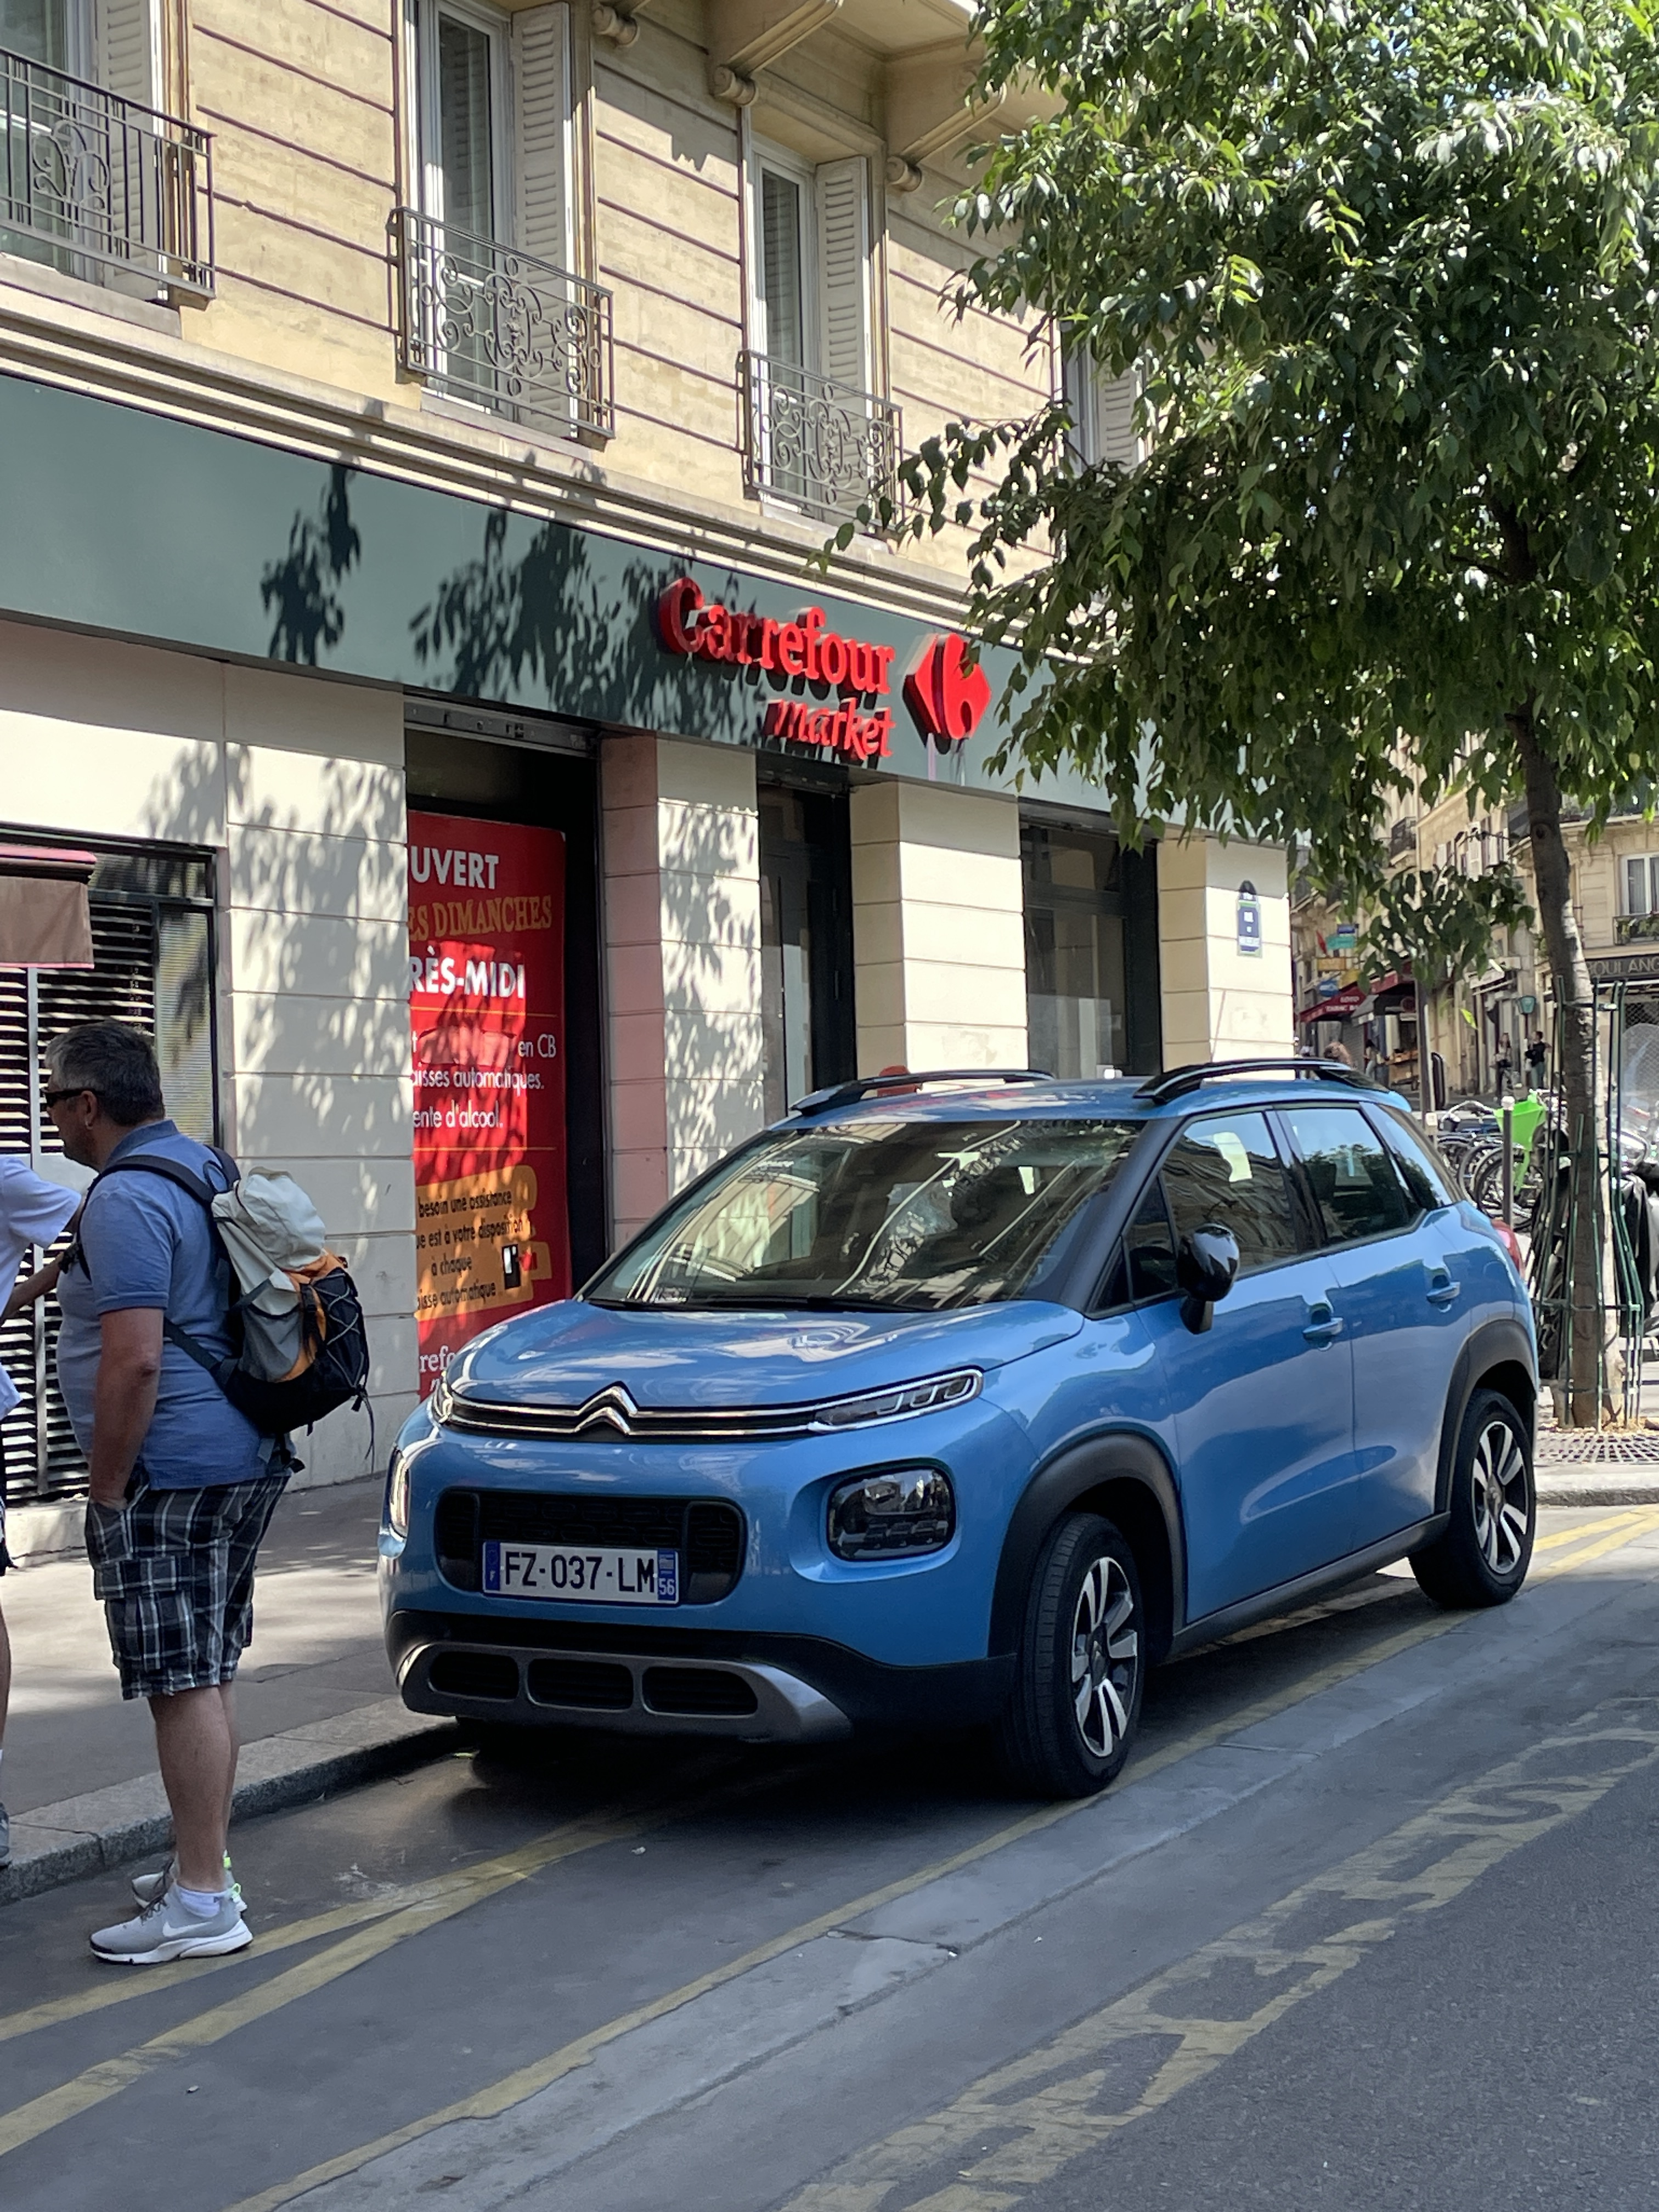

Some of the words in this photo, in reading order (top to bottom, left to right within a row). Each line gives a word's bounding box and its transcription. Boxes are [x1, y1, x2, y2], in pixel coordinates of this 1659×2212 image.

[660, 577, 895, 695] Carrefour
[768, 698, 896, 760] market
[410, 845, 499, 889] UVERT
[408, 903, 428, 942] ES
[432, 895, 552, 938] DIMANCHES
[409, 945, 526, 998] RÈS-MIDI
[518, 1040, 534, 1057] en
[537, 1033, 556, 1058] CB
[411, 1062, 450, 1087] aisses
[453, 1065, 545, 1097] automatiques.
[413, 1105, 442, 1128] ente
[445, 1099, 504, 1128] d'alcool.
[417, 1195, 448, 1218] besoin
[451, 1197, 467, 1213] une
[469, 1188, 512, 1210] assistance
[429, 1229, 442, 1246] est
[444, 1223, 451, 1245] à
[453, 1224, 476, 1243] votre
[478, 1213, 523, 1244] disposition
[431, 1256, 438, 1277] à
[440, 1252, 472, 1278] chaque
[439, 1278, 496, 1304] automatique
[419, 1345, 456, 1373] refo
[505, 1551, 655, 1593] FZ-037-LM
[659, 1578, 675, 1596] 56
